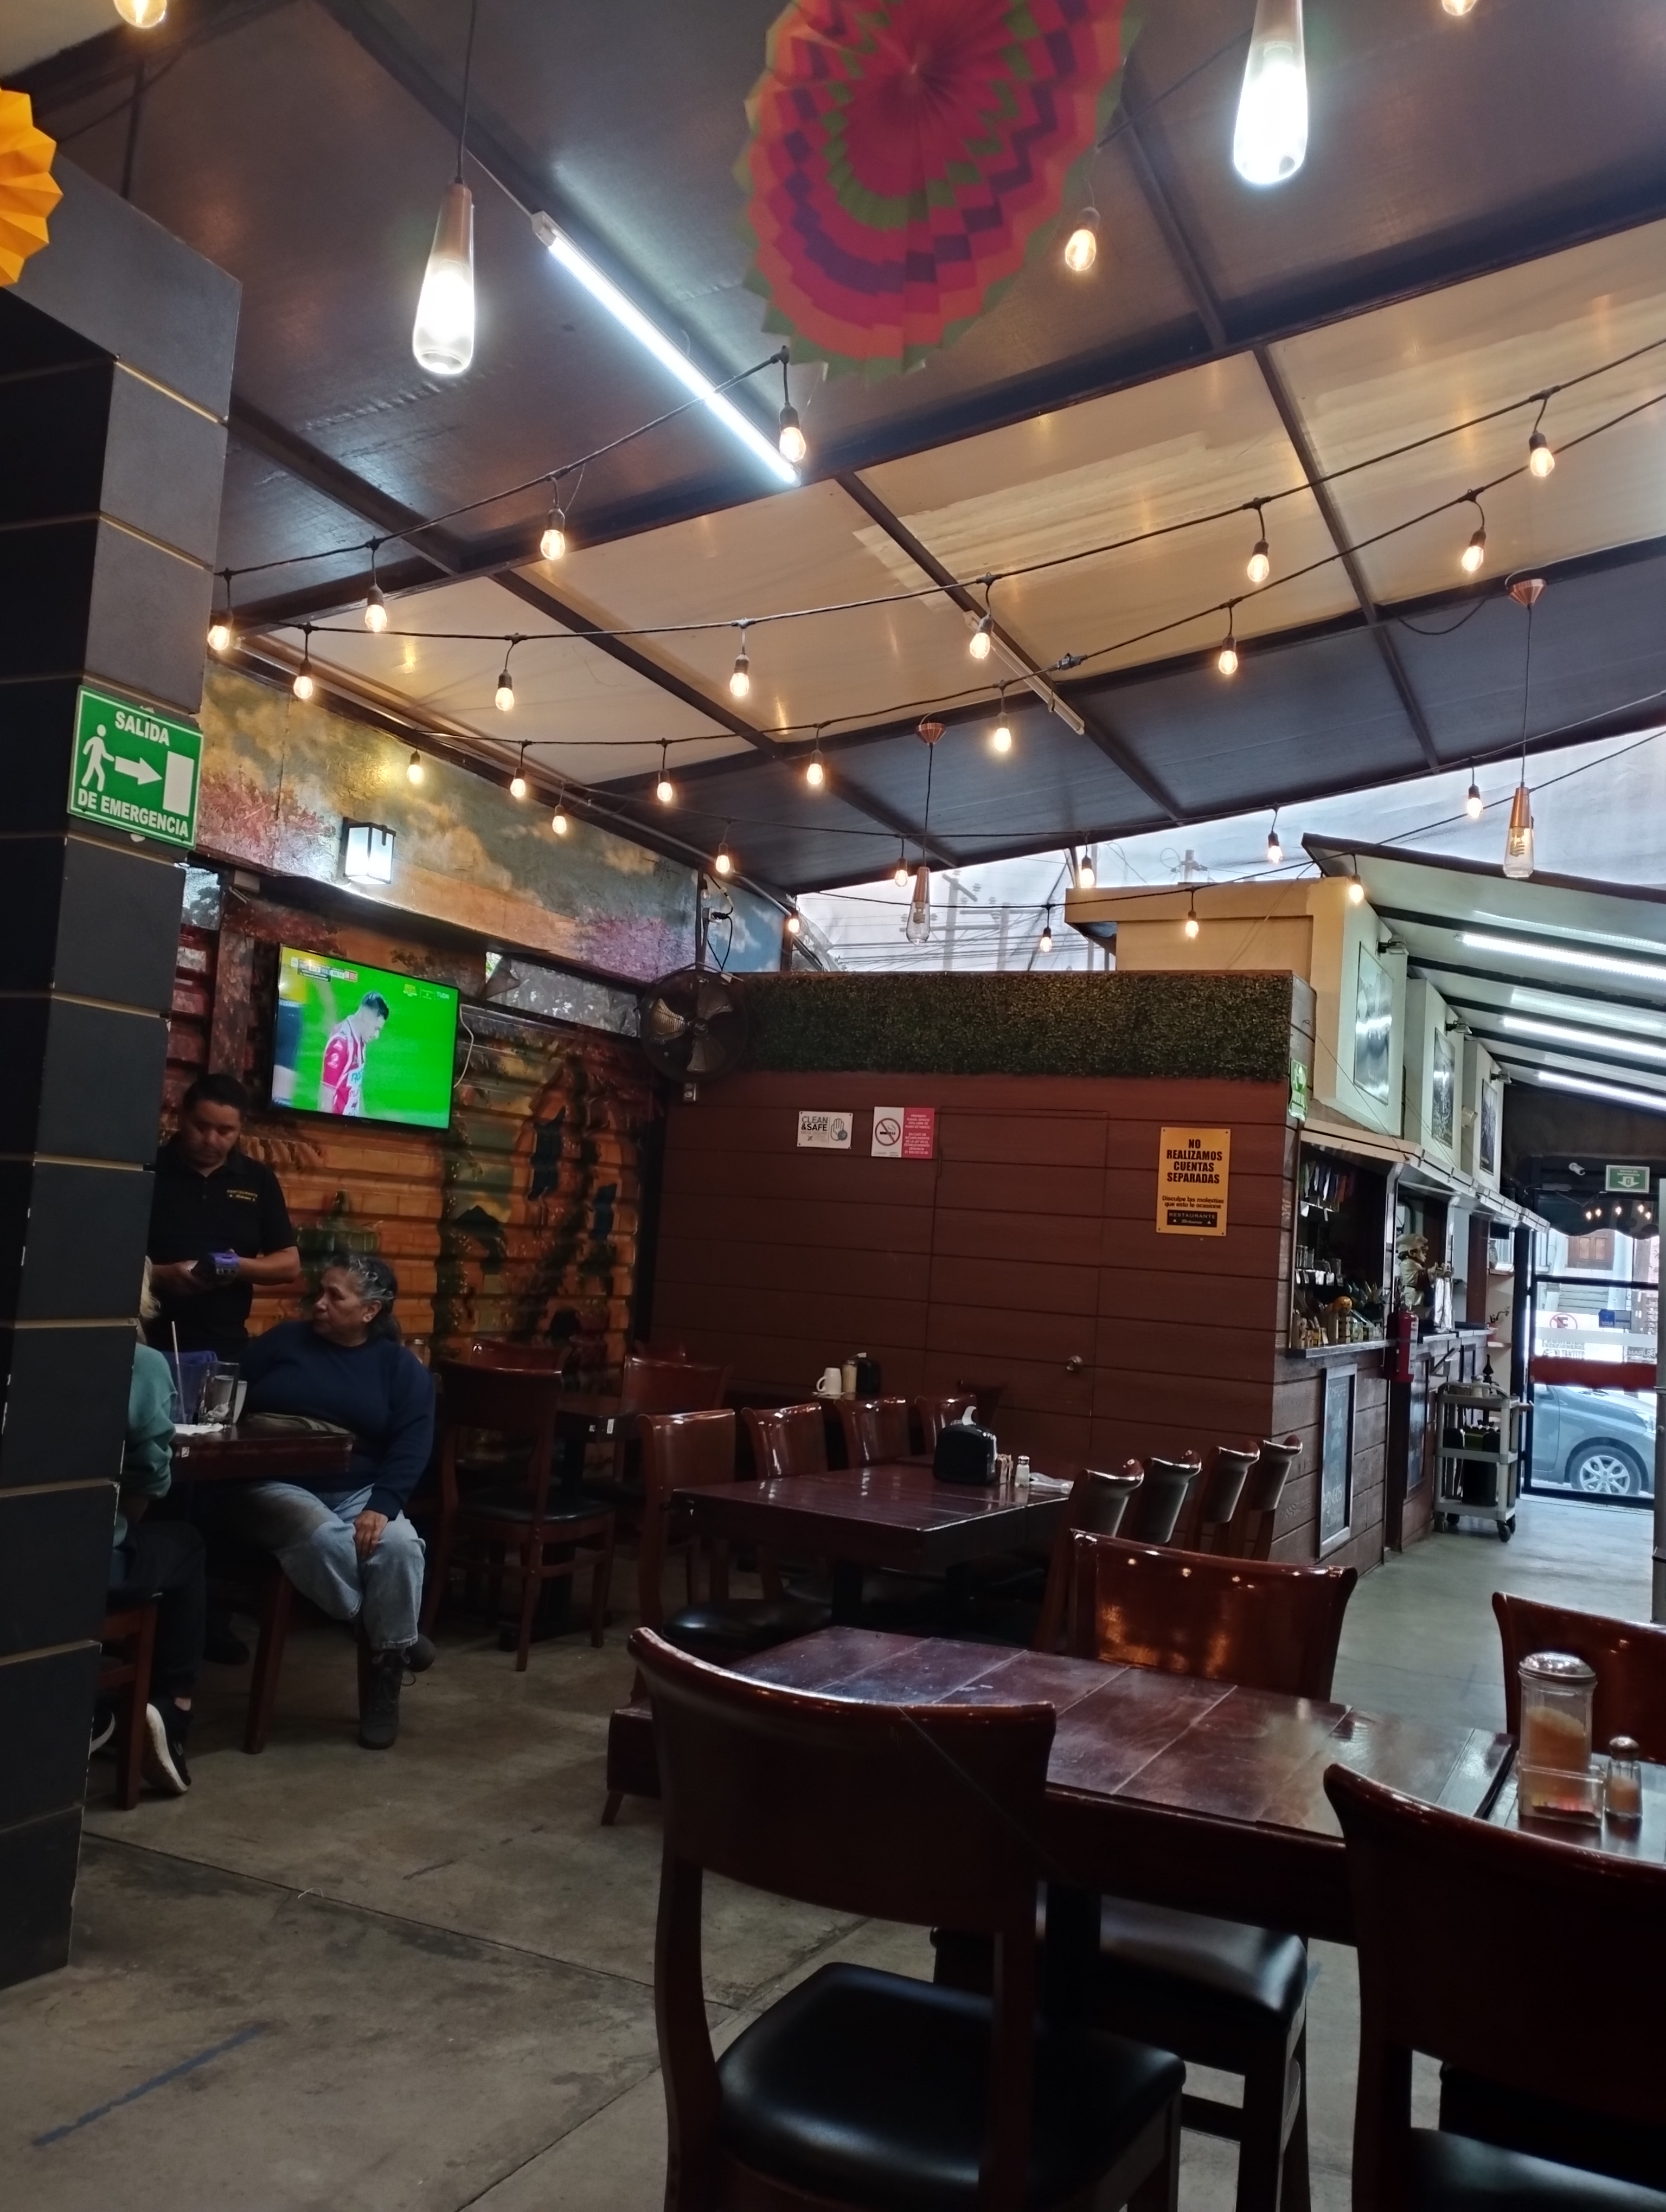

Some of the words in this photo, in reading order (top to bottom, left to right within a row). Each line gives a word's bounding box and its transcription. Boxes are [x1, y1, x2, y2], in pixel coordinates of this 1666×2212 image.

[115, 711, 170, 746] SALIDA
[78, 788, 98, 809] DE
[101, 795, 189, 838] EMERGENCIA
[801, 1123, 828, 1131] &SAFE
[1188, 1139, 1201, 1149] NO
[1167, 1149, 1222, 1161] REALIZAMOS
[1174, 1161, 1214, 1172] CUENTAS
[1167, 1173, 1220, 1184] SEPARADAS
